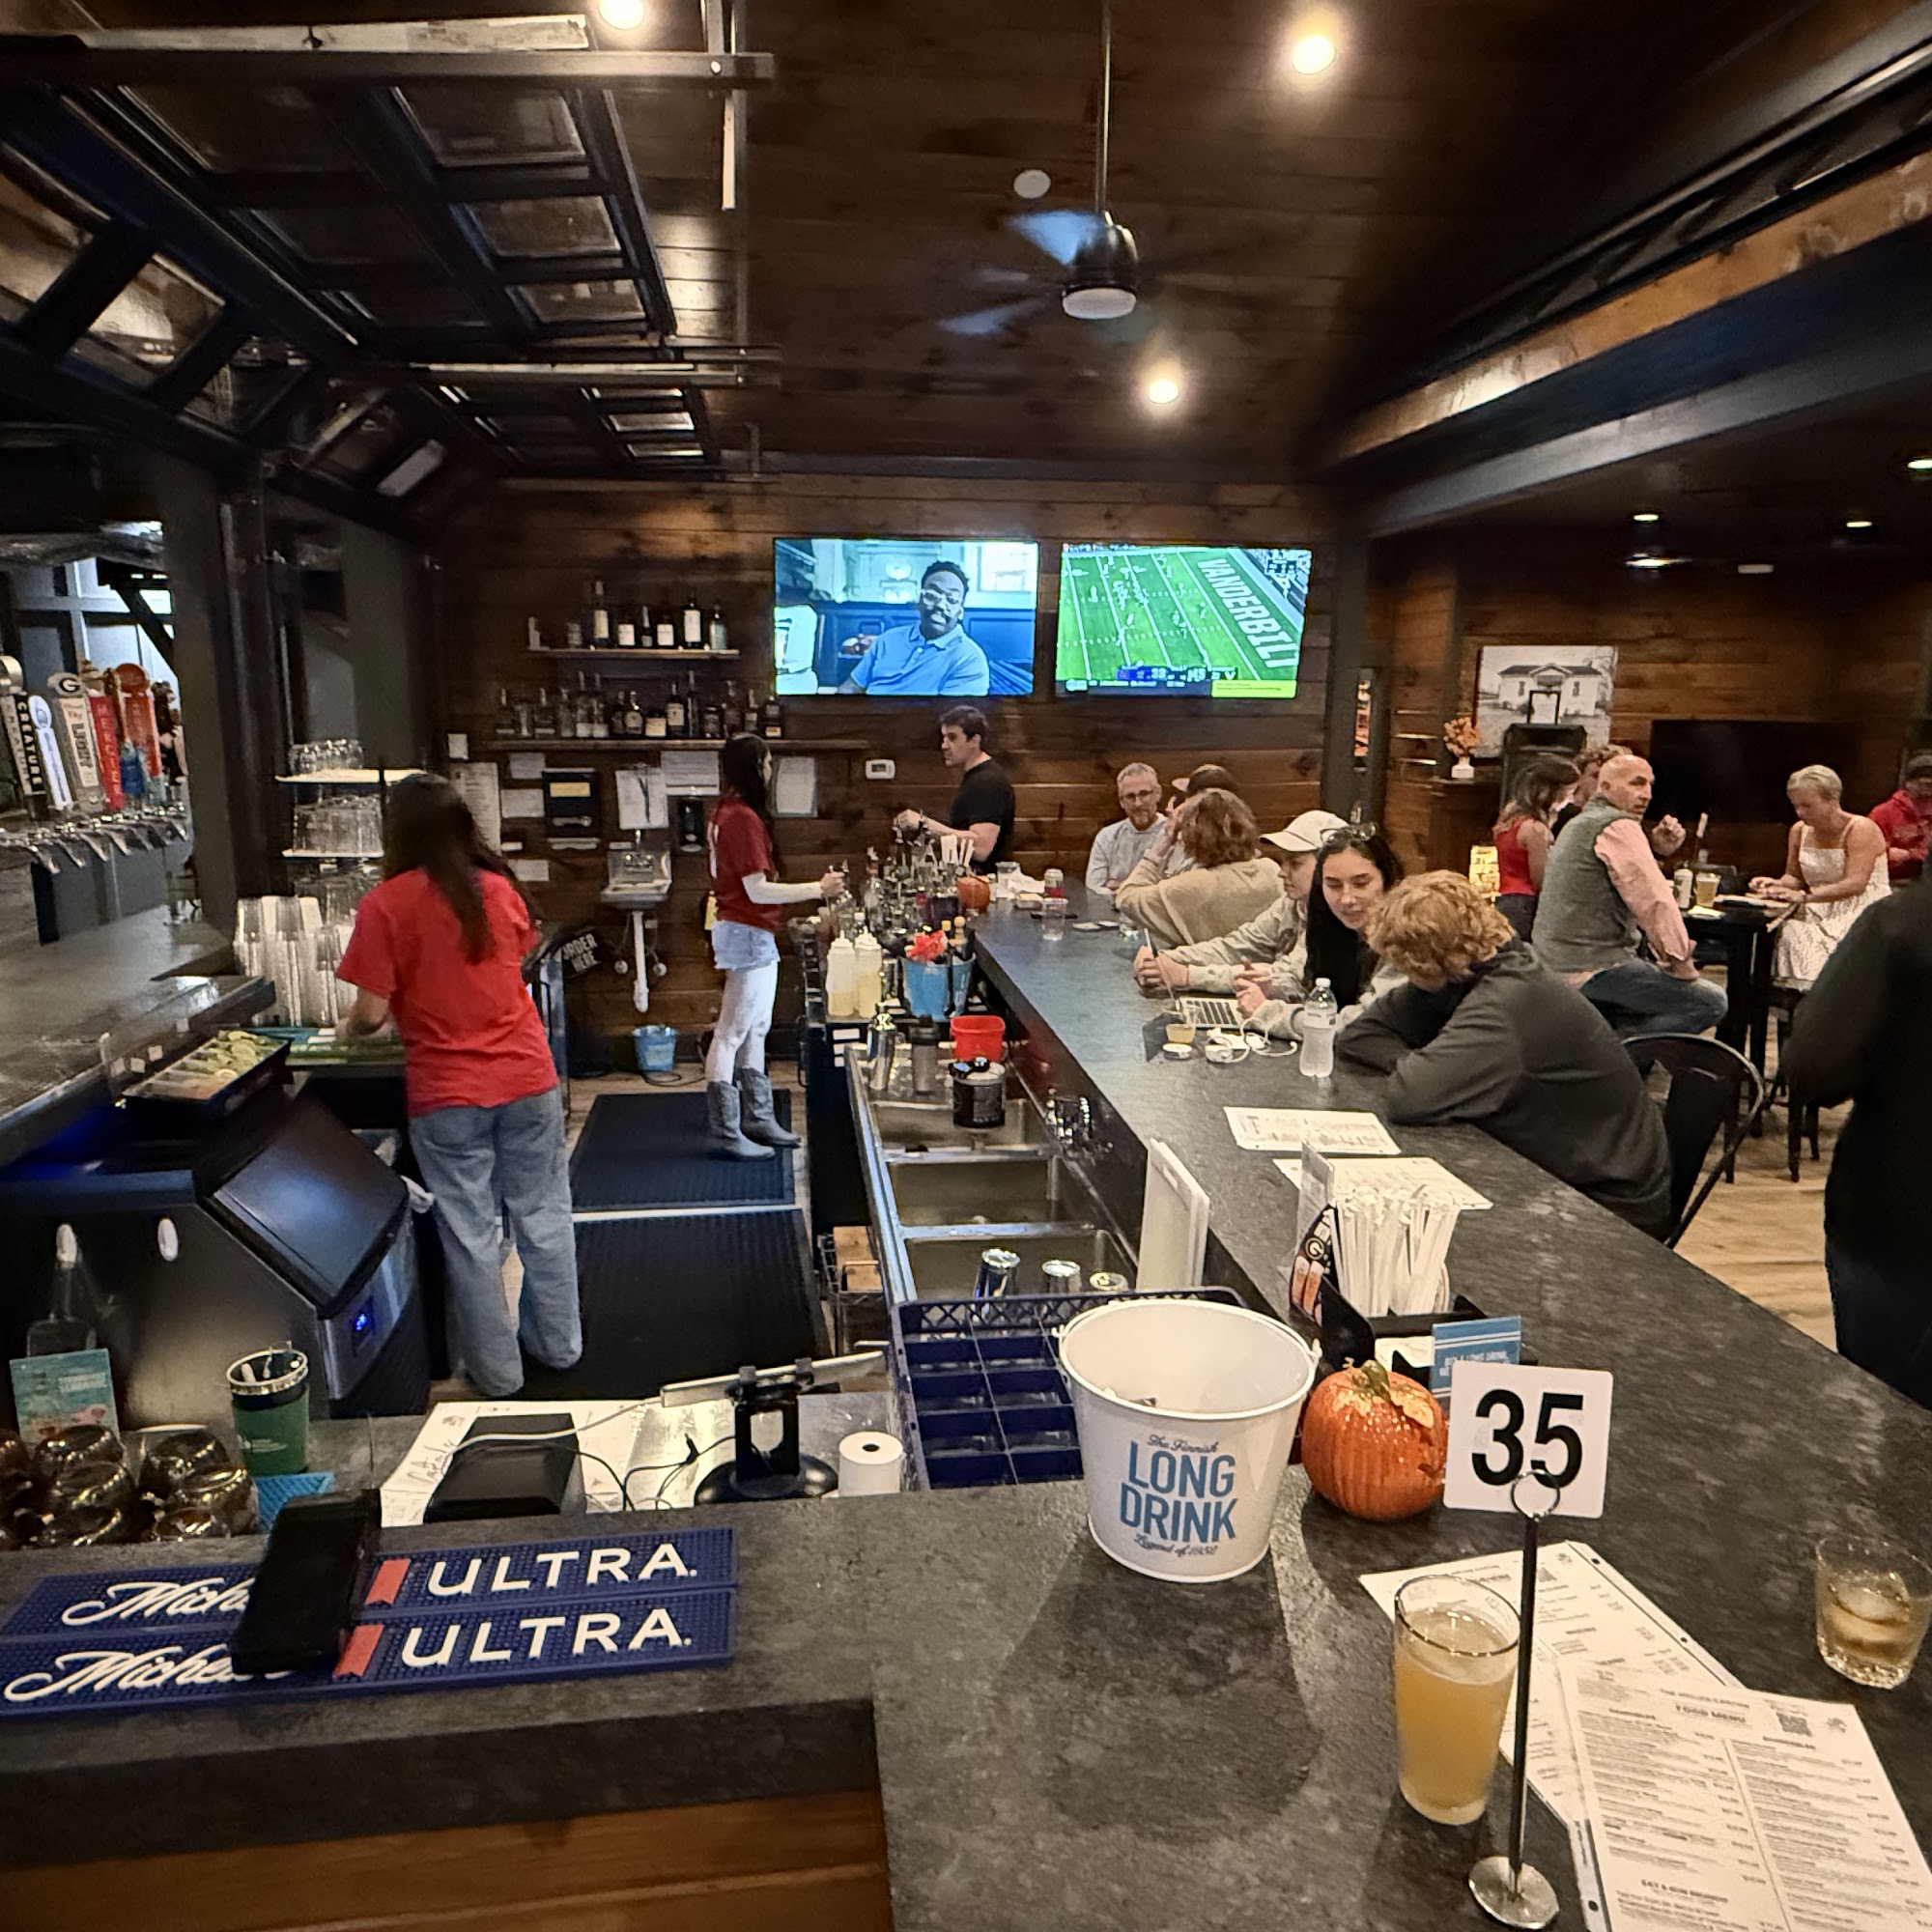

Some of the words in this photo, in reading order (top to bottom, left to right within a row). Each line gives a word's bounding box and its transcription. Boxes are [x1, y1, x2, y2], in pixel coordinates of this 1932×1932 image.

[1197, 558, 1299, 668] VANDERBILT
[17, 701, 43, 784] CREATURE
[1128, 1440, 1236, 1498] LONG
[1148, 1434, 1170, 1450] The
[1170, 1438, 1219, 1454] Finnish
[1471, 1389, 1583, 1488] 35
[1120, 1482, 1238, 1544] DRINK
